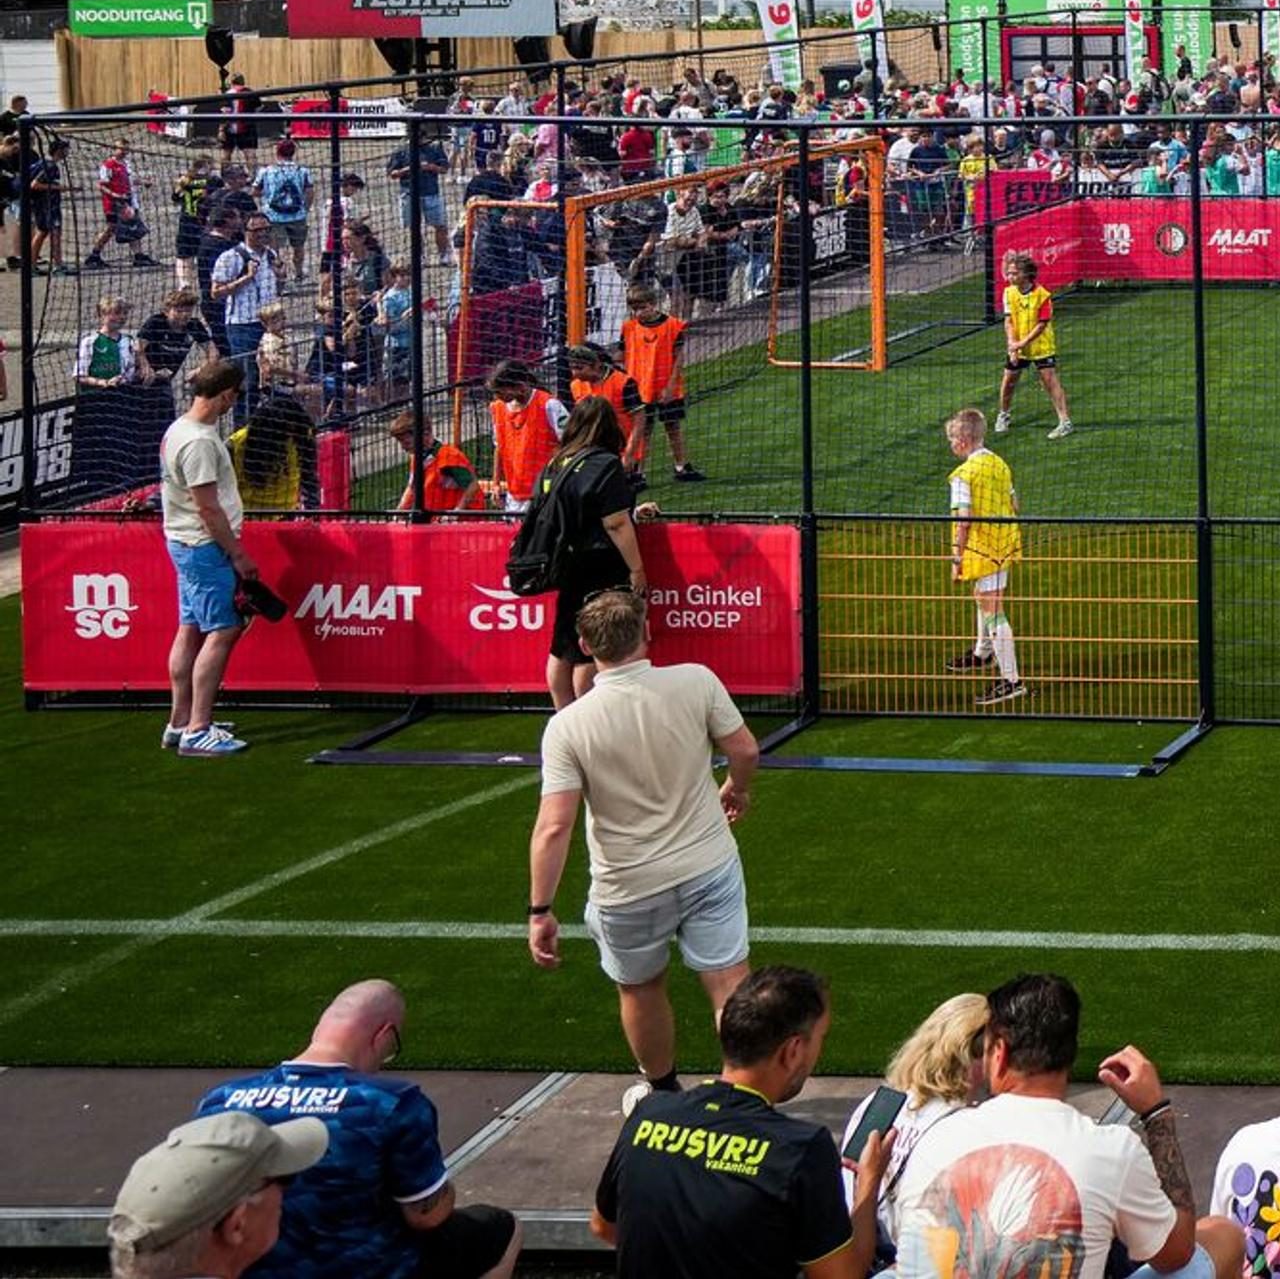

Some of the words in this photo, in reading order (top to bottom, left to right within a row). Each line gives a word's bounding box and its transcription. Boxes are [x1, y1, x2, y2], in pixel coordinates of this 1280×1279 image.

[75, 9, 184, 22] NOODUITGANG
[1207, 228, 1272, 246] MAAT
[294, 584, 422, 620] MAAT
[687, 585, 762, 606] Ginkel
[469, 604, 545, 630] CSU
[666, 611, 741, 628] GROEP
